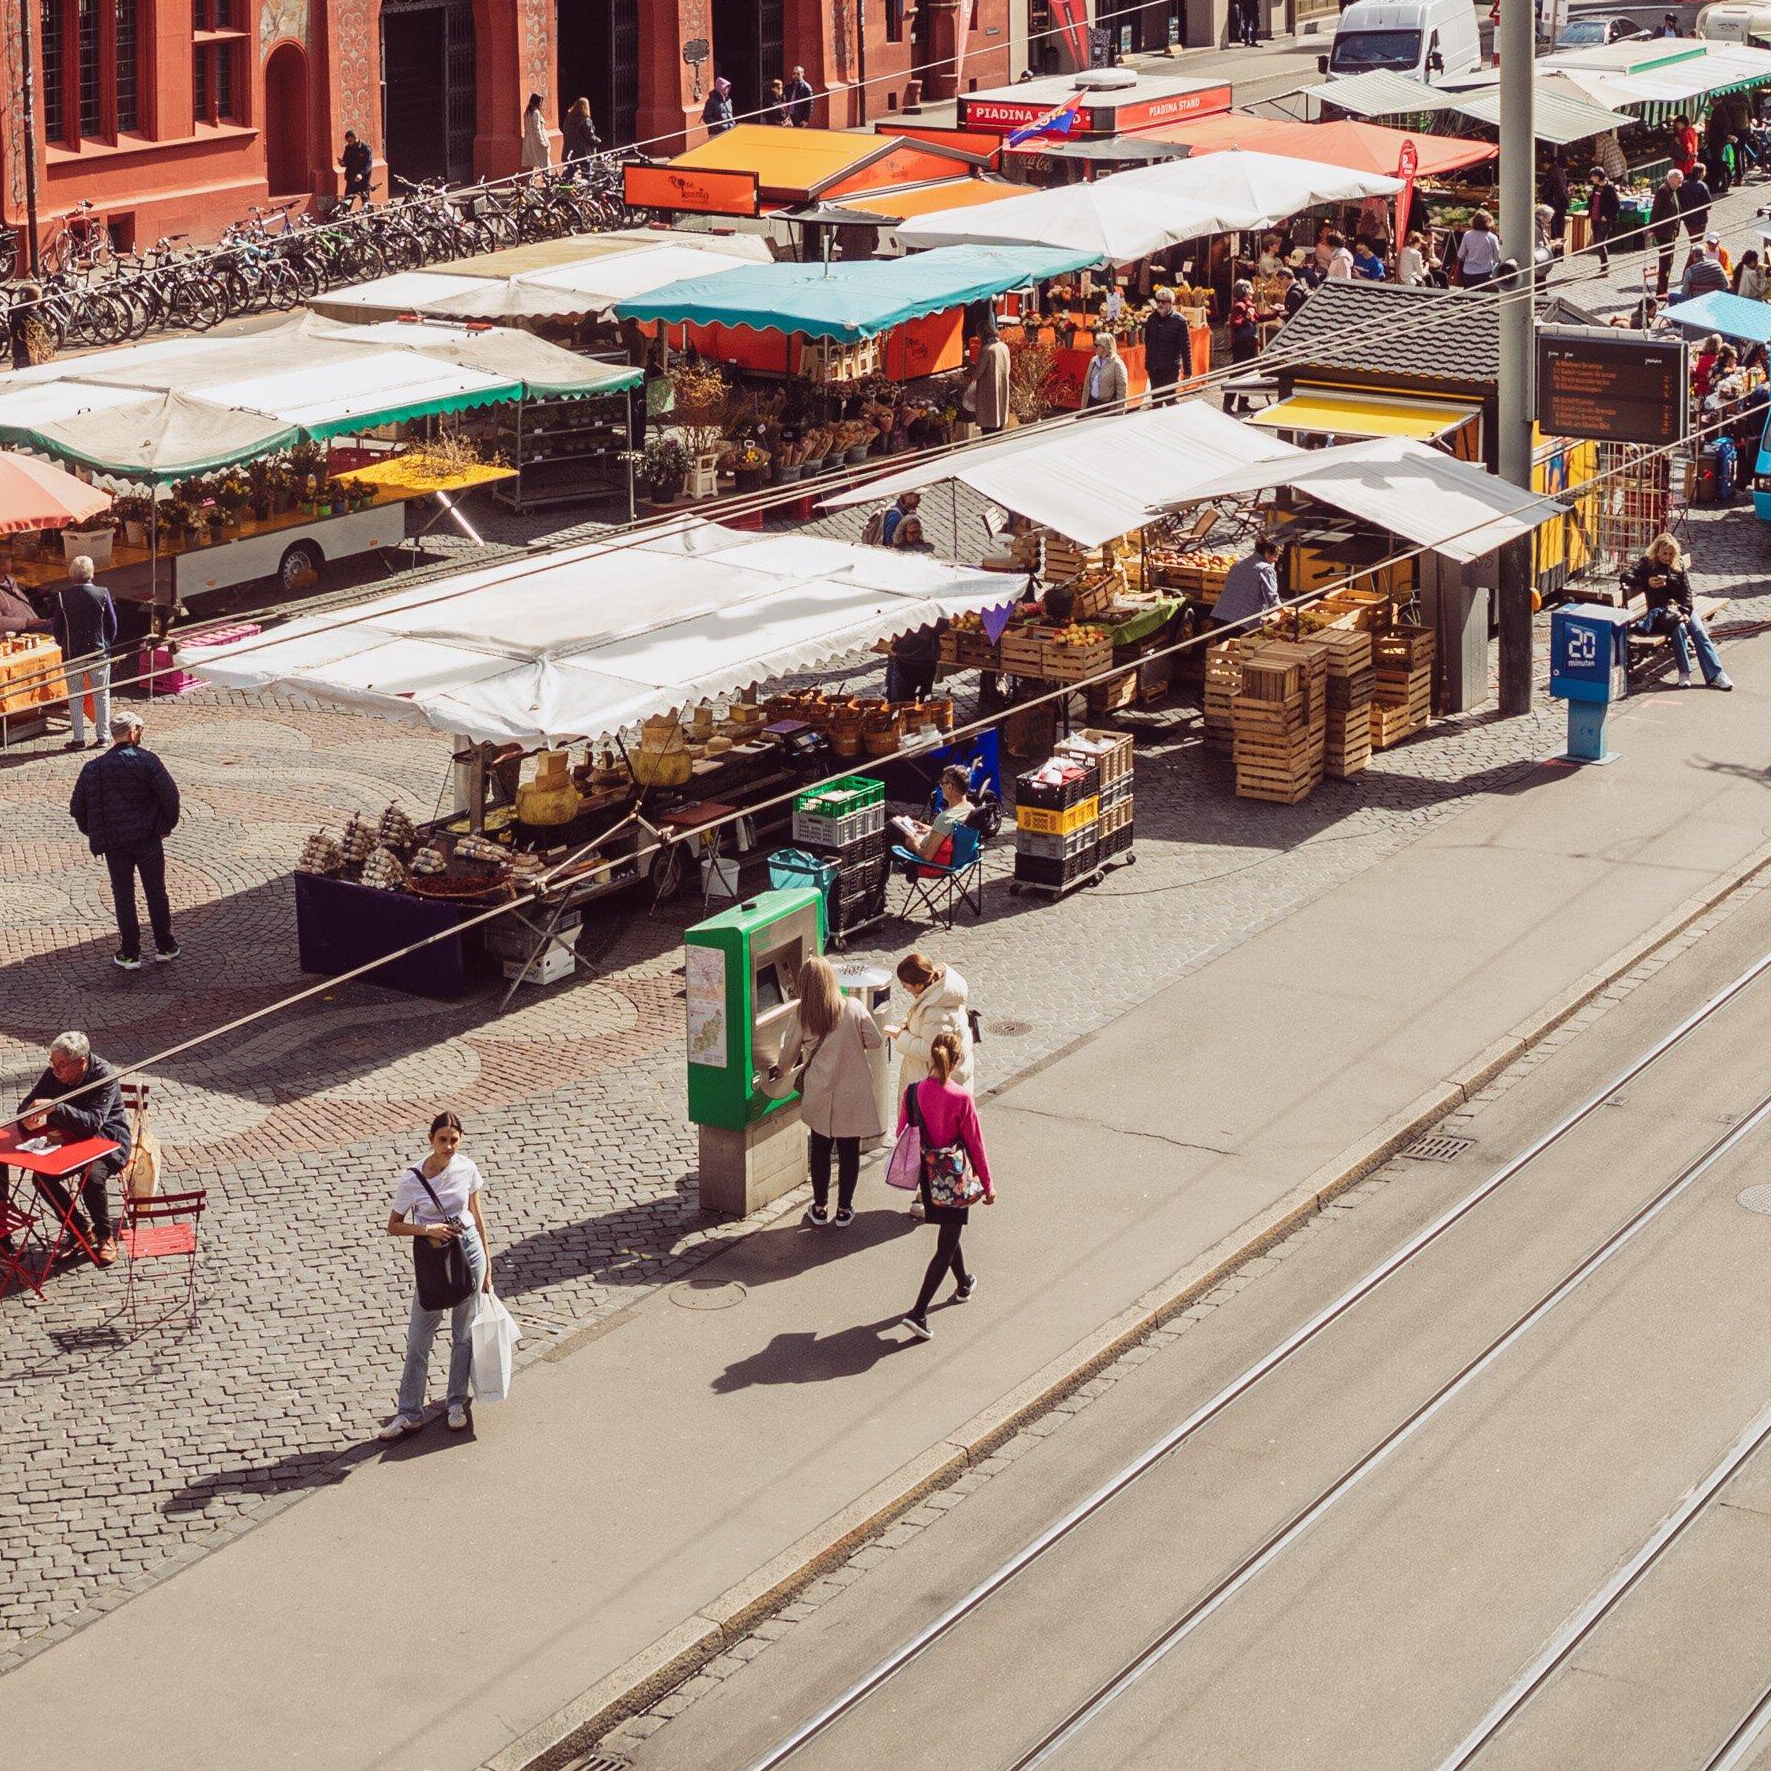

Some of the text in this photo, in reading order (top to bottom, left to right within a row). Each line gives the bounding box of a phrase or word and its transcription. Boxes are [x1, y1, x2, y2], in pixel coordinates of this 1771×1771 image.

[975, 106, 1033, 121] PIADINA
[1147, 97, 1201, 118] PIADINA STAND
[1568, 627, 1597, 659] 20
[1568, 658, 1596, 667] minuten
